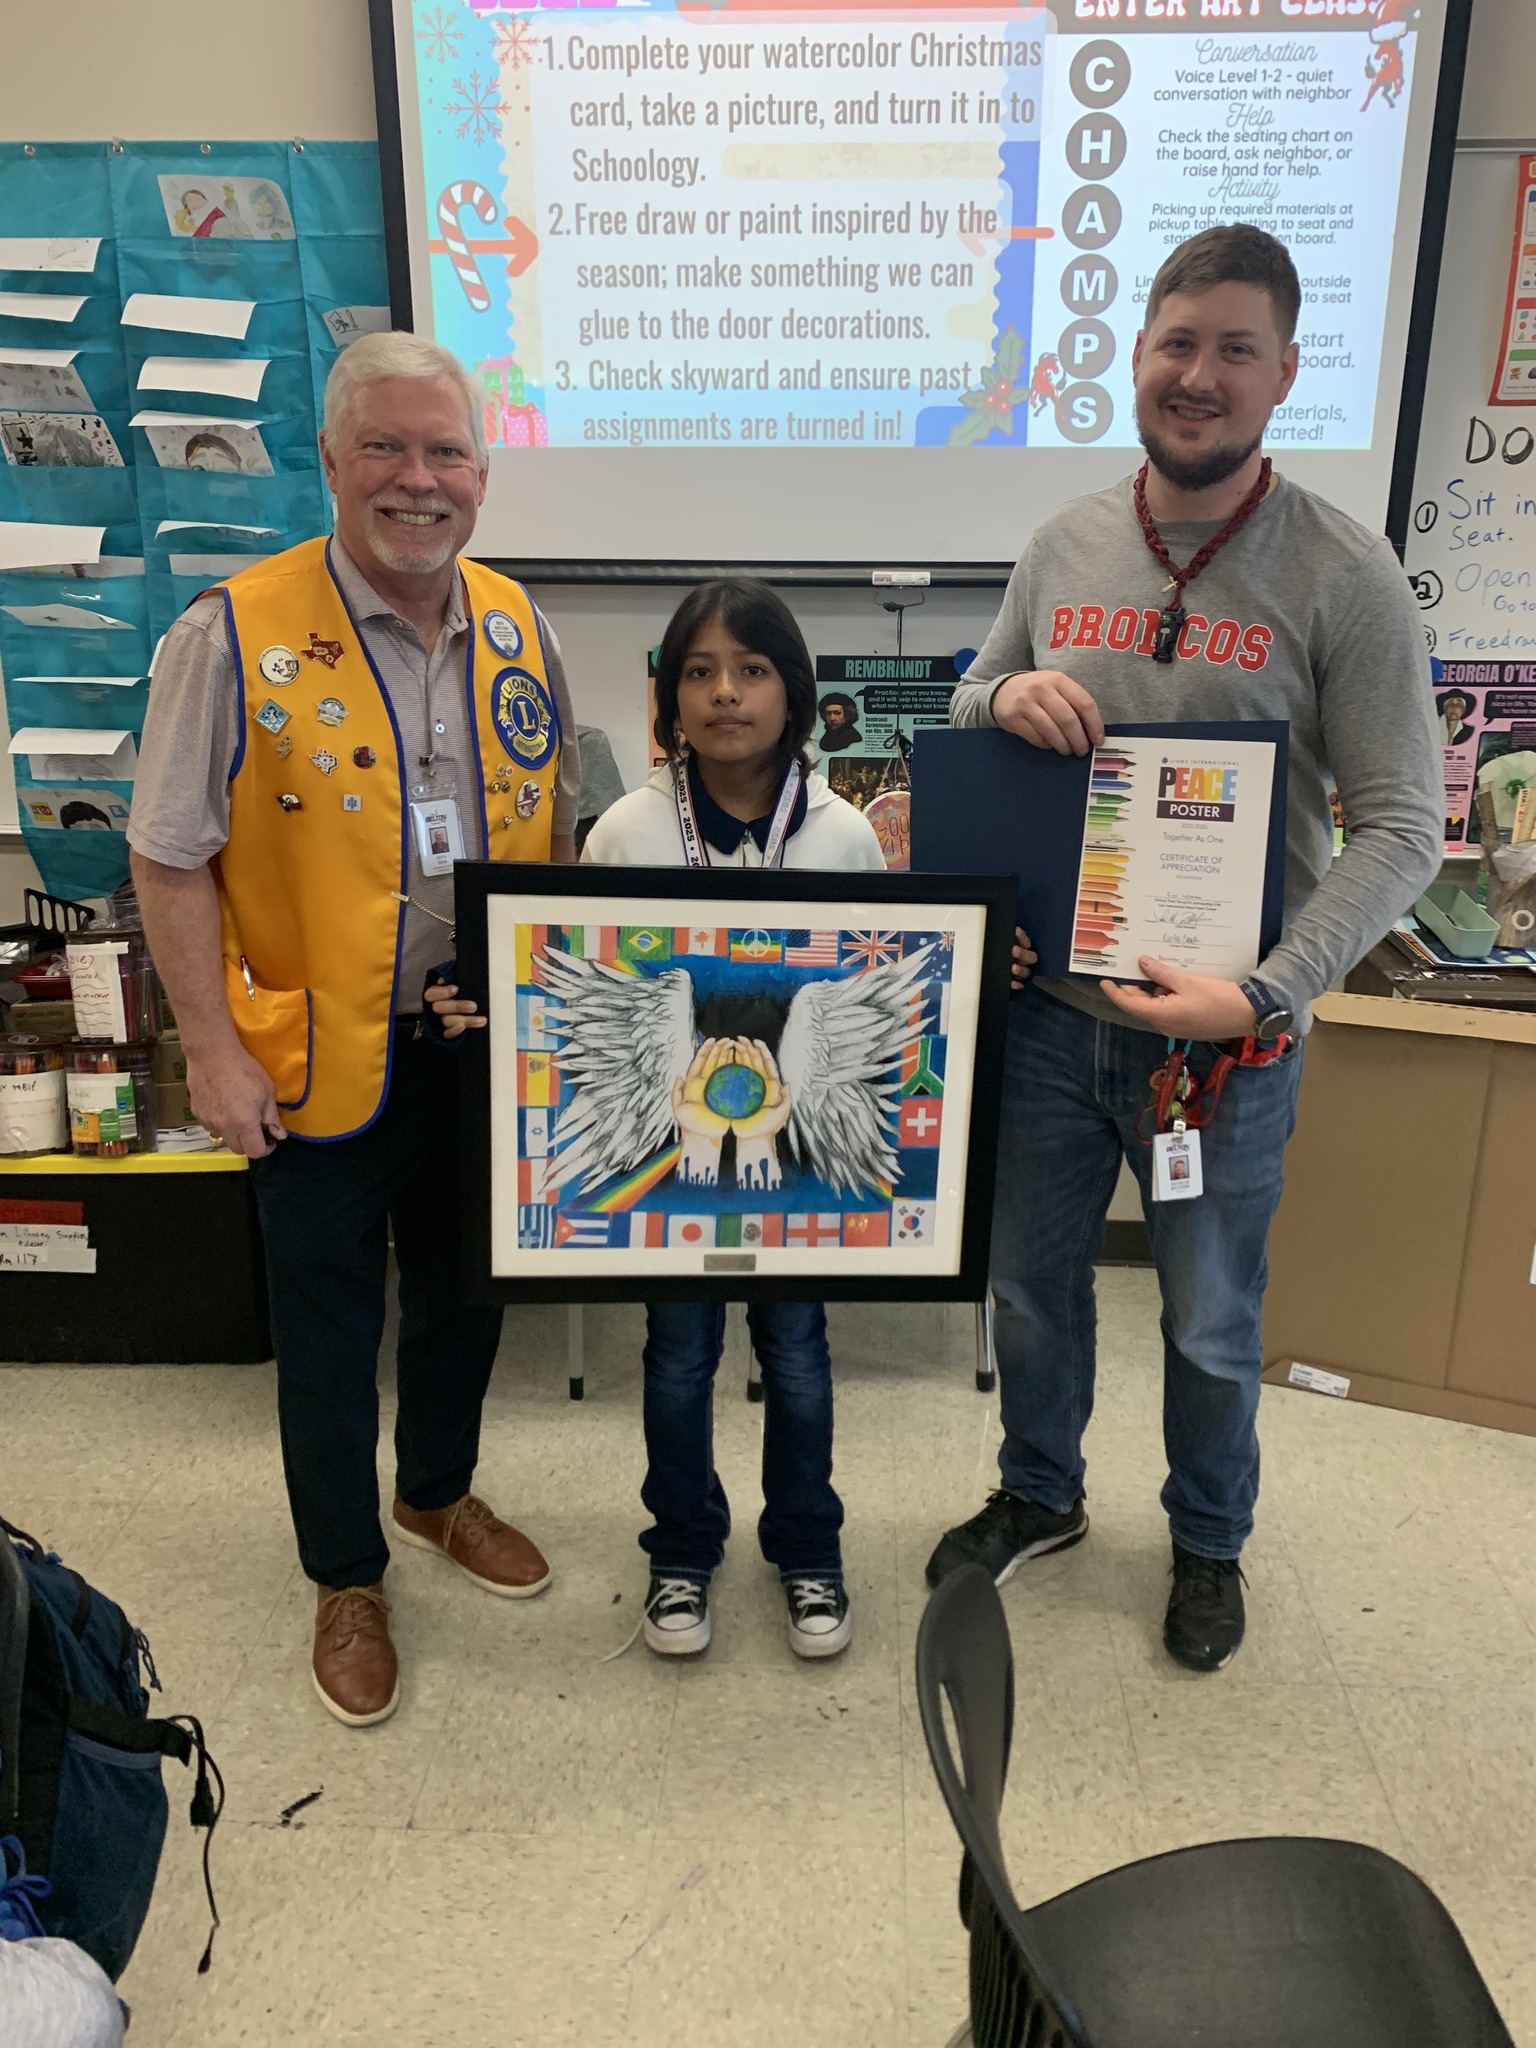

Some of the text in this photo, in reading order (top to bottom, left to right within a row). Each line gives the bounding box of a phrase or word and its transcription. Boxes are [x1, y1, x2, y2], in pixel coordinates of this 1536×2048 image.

[698, 43, 754, 75] your
[763, 33, 901, 69] watercolor
[911, 32, 1042, 67] Christmas
[1195, 38, 1318, 65] Conversation
[1175, 70, 1214, 83] Voice
[1219, 69, 1257, 83] Level
[1261, 69, 1282, 83] 1-2
[1296, 69, 1333, 85] quiet
[1153, 86, 1352, 103] conversation with neighbor
[570, 90, 1035, 133] card, take a picture, and turn it in to
[1226, 102, 1275, 131] Help
[1158, 128, 1353, 145] Check the seating chart on
[1156, 146, 1353, 163] the board, ask neighbor, or
[572, 148, 706, 188] Schoology.
[1183, 162, 1322, 179] raise hand for help.
[1208, 174, 1281, 205] Activity
[1152, 202, 1354, 219] Picking up required materials at
[636, 202, 697, 235] draw
[705, 209, 731, 235] or
[739, 202, 802, 242] paint
[811, 201, 911, 241] inspired
[920, 201, 949, 239] by
[957, 201, 998, 234] the
[1149, 218, 1354, 232] pickup to seat and
[1294, 232, 1337, 244] board.
[576, 255, 974, 294] season; make something we can
[1301, 275, 1352, 288] outside
[1304, 292, 1352, 304] to seat
[579, 307, 930, 346] glue to the door decorations.
[1301, 332, 1344, 347] start
[555, 359, 972, 397] 3. Check skyward and ensure past
[1272, 404, 1347, 423] aterials,
[583, 410, 902, 446] assignments are turned in!
[1263, 424, 1324, 440] tarted!
[1447, 479, 1497, 520] Sit
[1449, 525, 1513, 551] Seat.
[1455, 563, 1531, 606] Open
[1493, 595, 1516, 613] Go
[1049, 604, 1274, 673] BRONCOS
[845, 659, 933, 679] REMBRANDT
[507, 681, 536, 696] LIONS
[516, 701, 536, 730] L
[678, 779, 688, 803] 2025
[1158, 766, 1238, 801] PEACE
[1169, 804, 1220, 818] POSTER
[683, 816, 695, 842] 2025
[1163, 831, 1224, 844] Together As One
[1160, 852, 1223, 864] CERTIFICATE OF
[1160, 863, 1220, 874] APPRECIATION
[17, 1253, 38, 1266] 117
